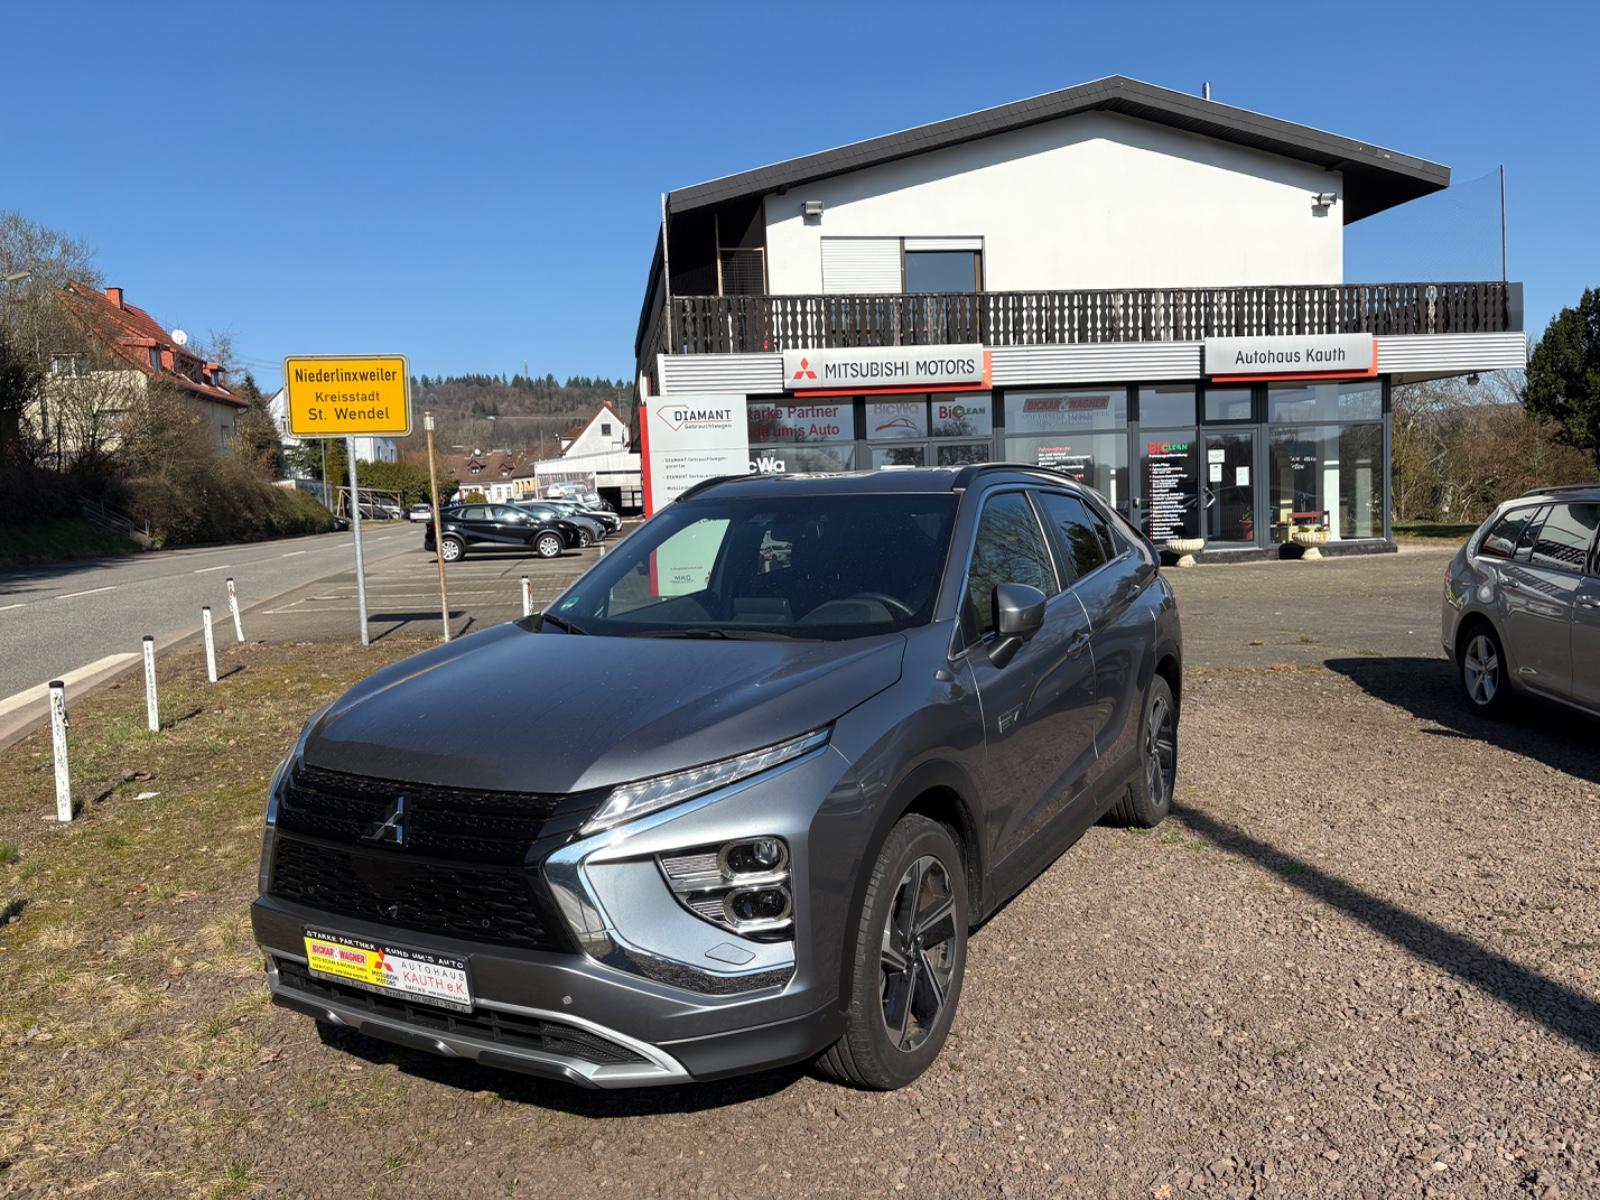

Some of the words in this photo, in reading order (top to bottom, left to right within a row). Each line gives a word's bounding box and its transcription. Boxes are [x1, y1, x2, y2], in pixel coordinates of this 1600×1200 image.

[1235, 350, 1300, 365] Autohaus
[1306, 348, 1345, 362] Kauth
[295, 368, 397, 382] Niederlinxweiler
[825, 361, 909, 379] MITSUBISHI
[916, 359, 975, 376] MOTORS
[315, 391, 380, 402] Kreisstadt
[308, 408, 327, 420] St.
[335, 407, 389, 420] Wendel
[674, 410, 731, 421] DIAMANT
[748, 405, 783, 420] tarke
[788, 405, 838, 418] Partner
[809, 423, 840, 436] Auto
[749, 457, 785, 473] cWa
[306, 930, 336, 942] STARKE
[340, 937, 376, 950] PARTNER
[385, 947, 409, 957] RUND
[438, 959, 464, 969] AUTO
[340, 951, 365, 964] WAGNER
[401, 962, 465, 981] AUTOHAUS
[403, 971, 443, 989] KAUTH
